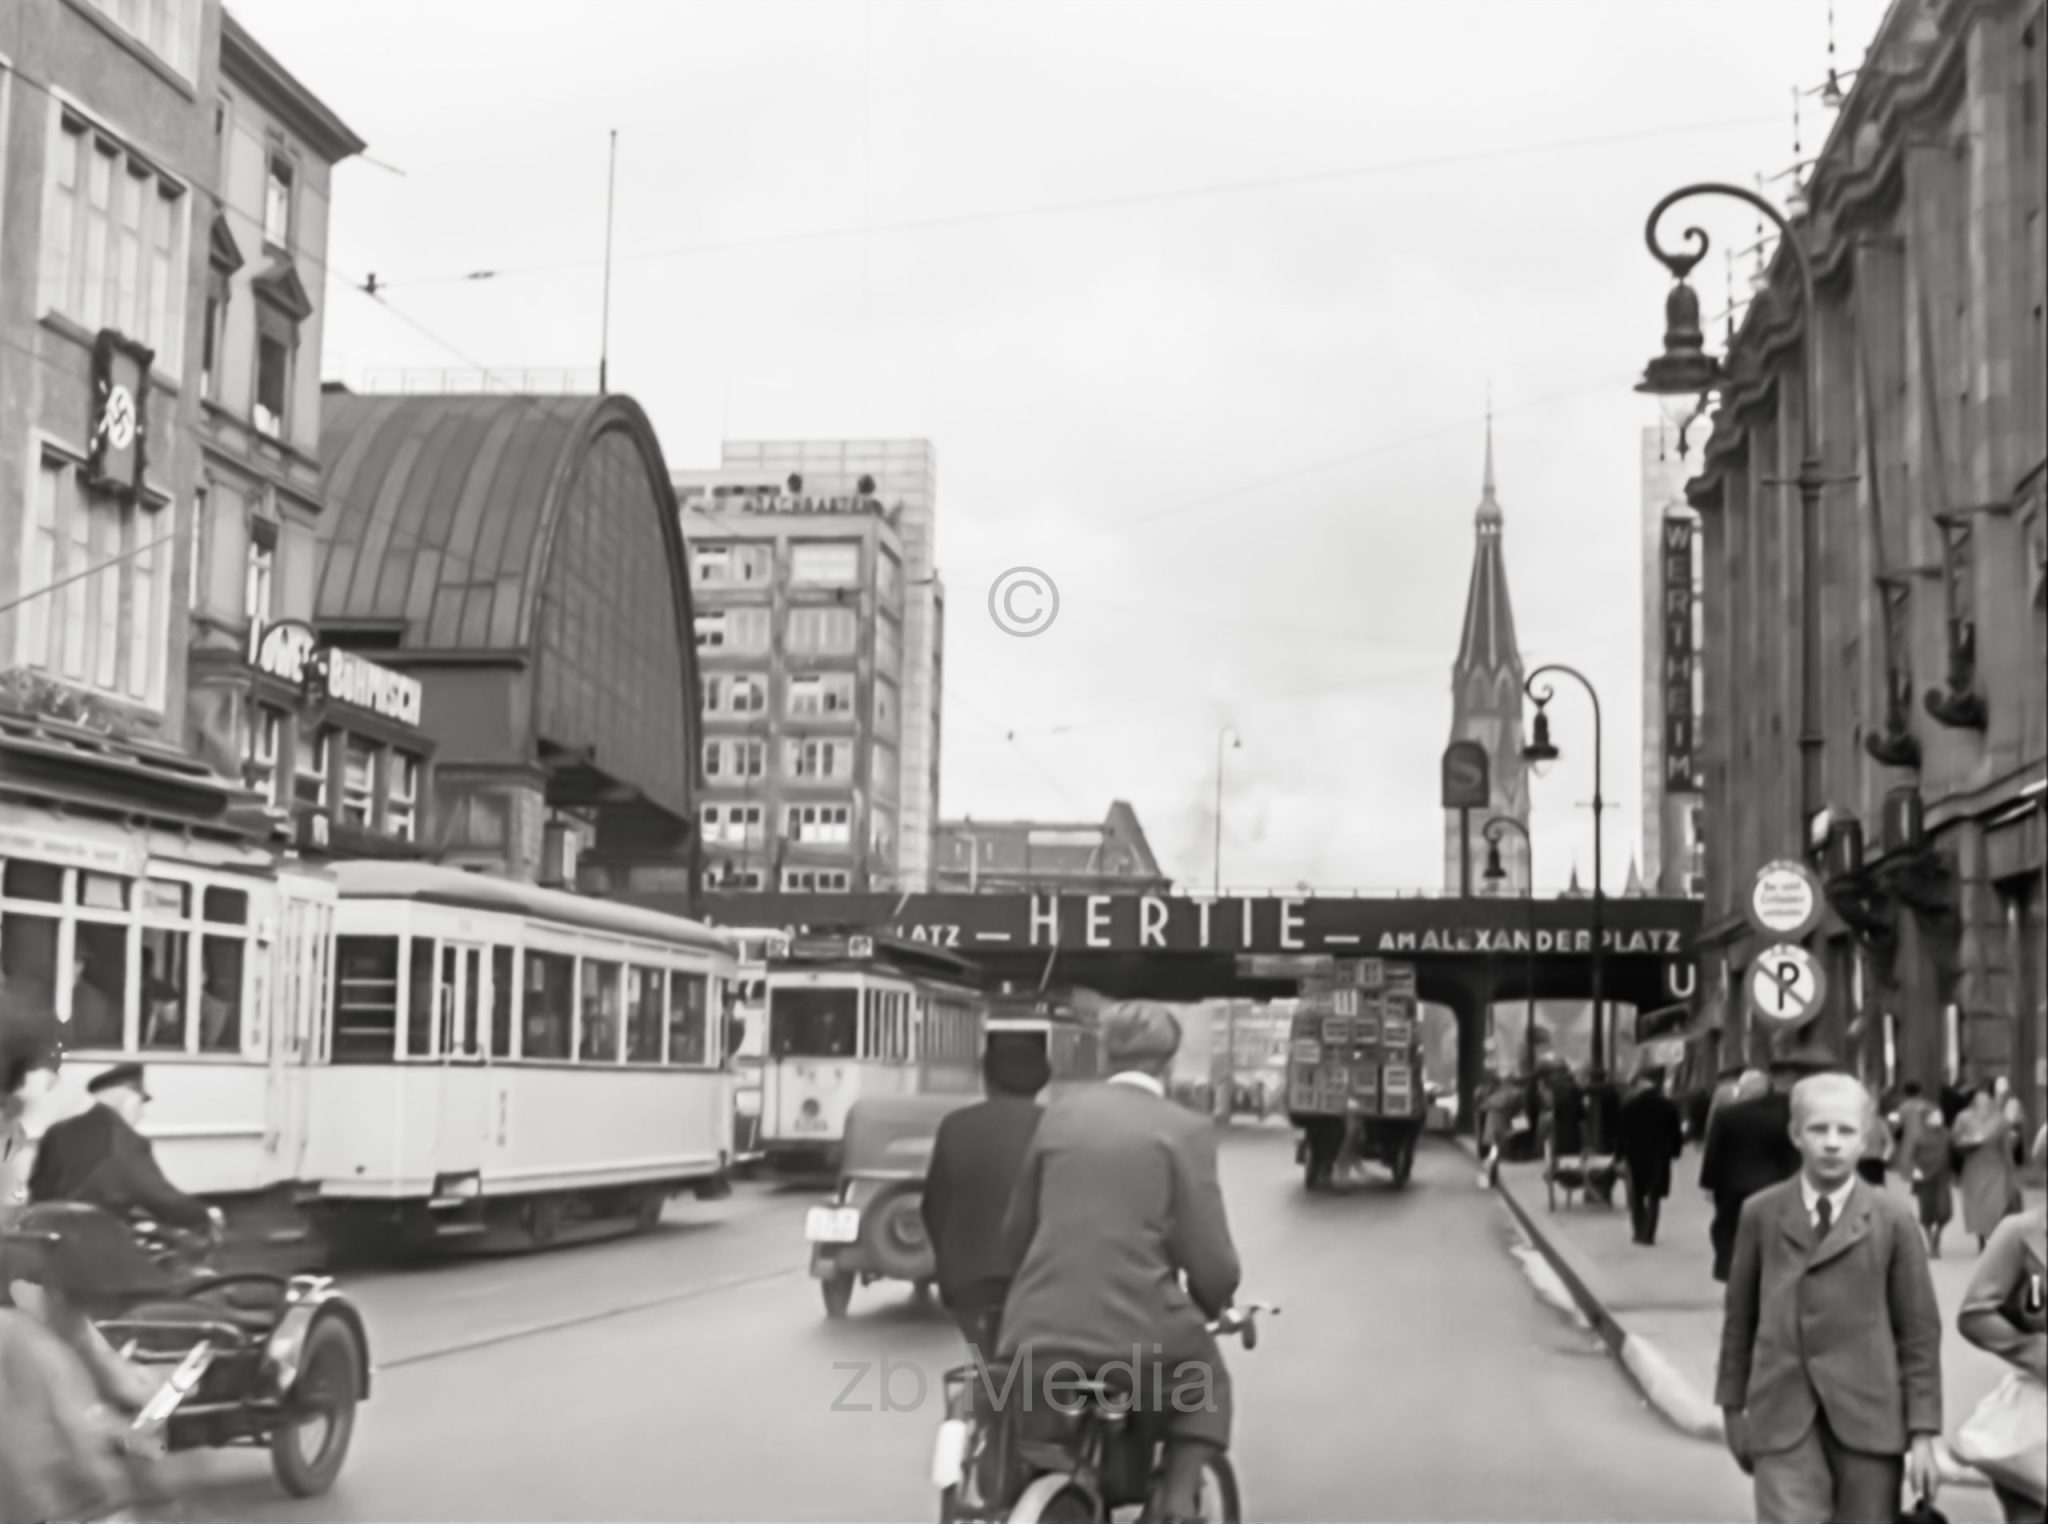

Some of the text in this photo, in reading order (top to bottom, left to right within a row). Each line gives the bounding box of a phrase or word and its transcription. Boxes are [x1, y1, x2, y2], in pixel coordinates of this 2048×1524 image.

[1666, 524, 1690, 782] WERTHEIM
[1029, 895, 1307, 949] HERTIE
[1668, 963, 1696, 998] U
[1777, 961, 1801, 1011] P
